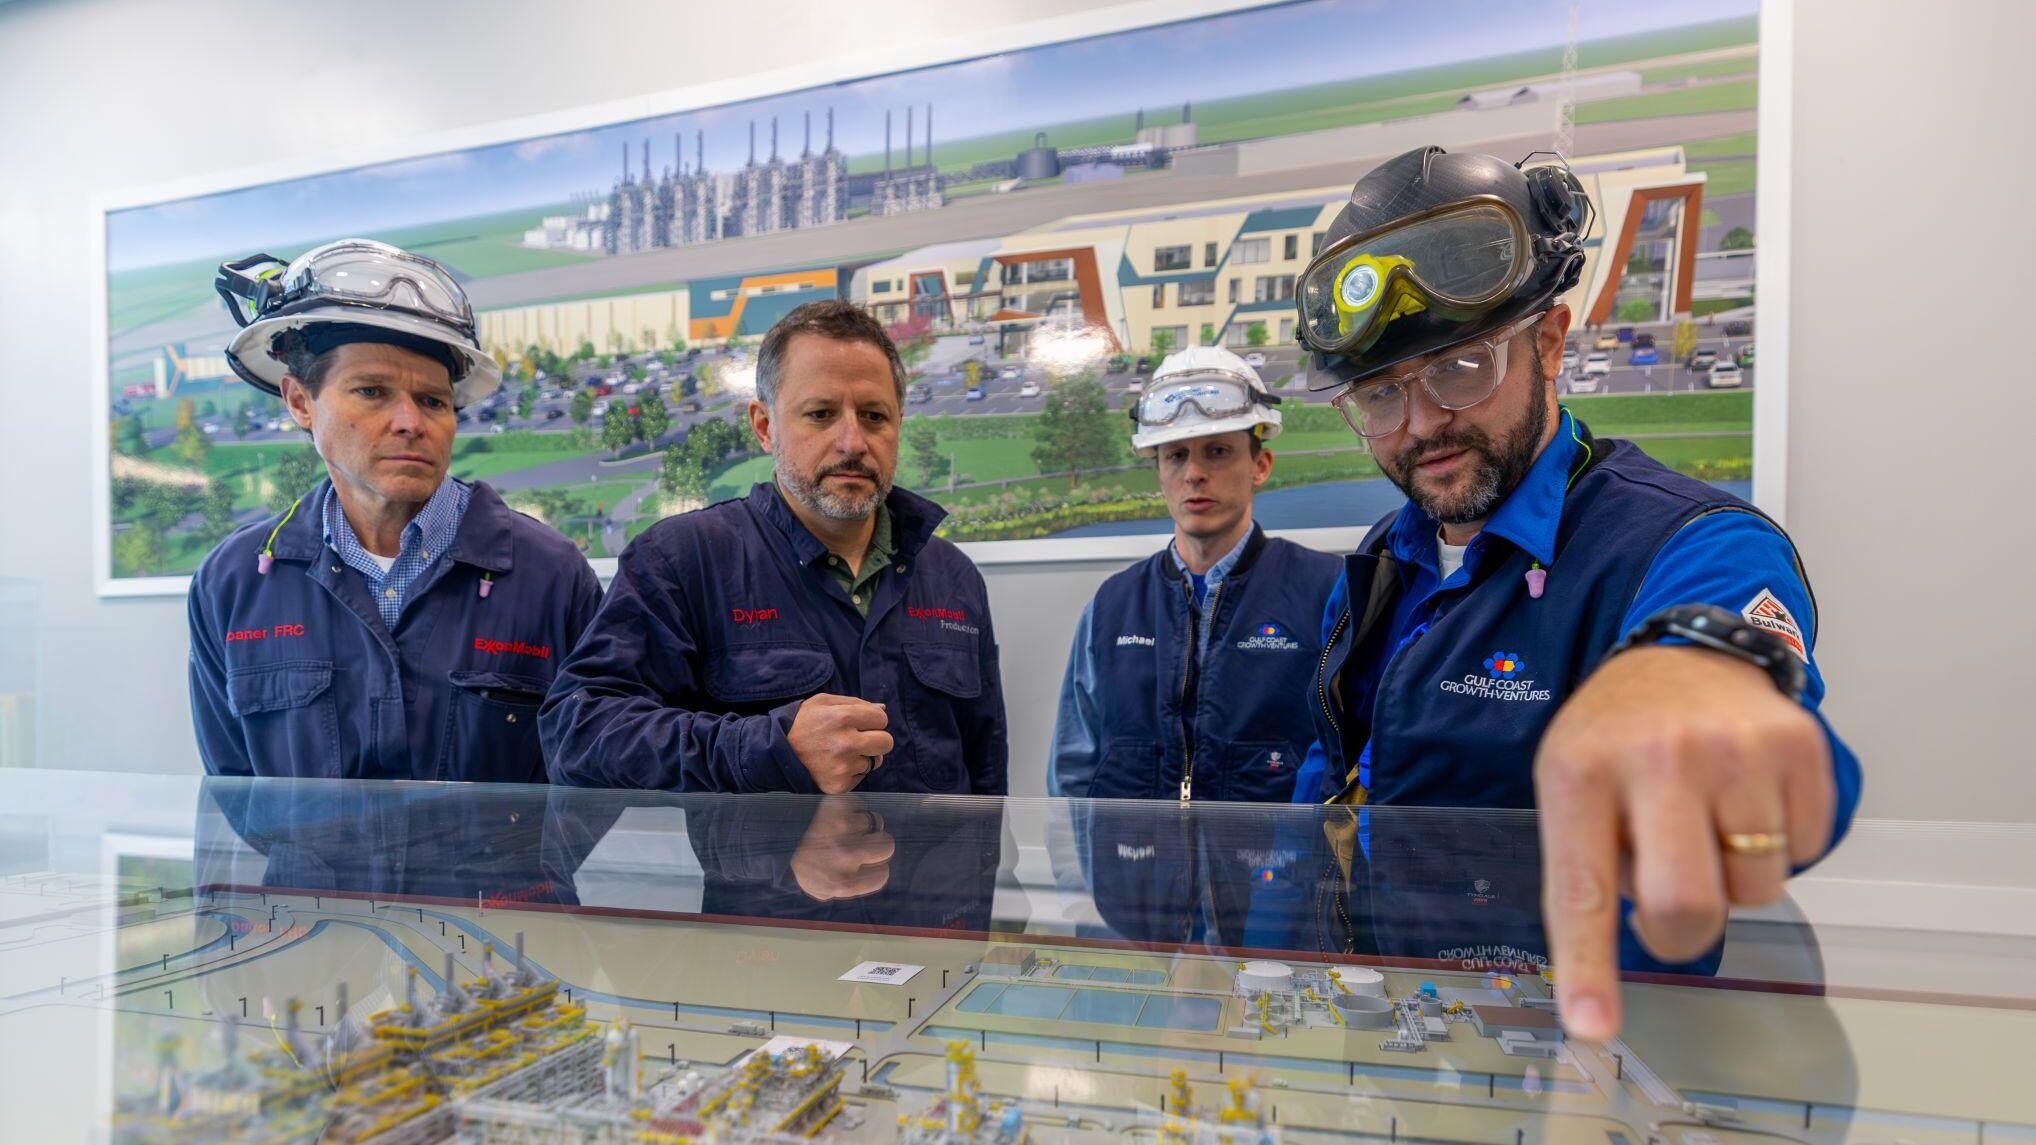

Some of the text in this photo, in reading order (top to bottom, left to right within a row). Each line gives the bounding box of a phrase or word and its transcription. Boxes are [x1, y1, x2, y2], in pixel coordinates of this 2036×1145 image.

[732, 607, 779, 624] Dylan
[274, 623, 305, 638] FRC
[474, 637, 550, 659] ExxonMobil
[1116, 634, 1155, 647] Michael
[1249, 636, 1288, 645] GULF COAST
[1440, 680, 1551, 701] GROWTH VENTURES
[1464, 674, 1534, 691] GULF COAST
